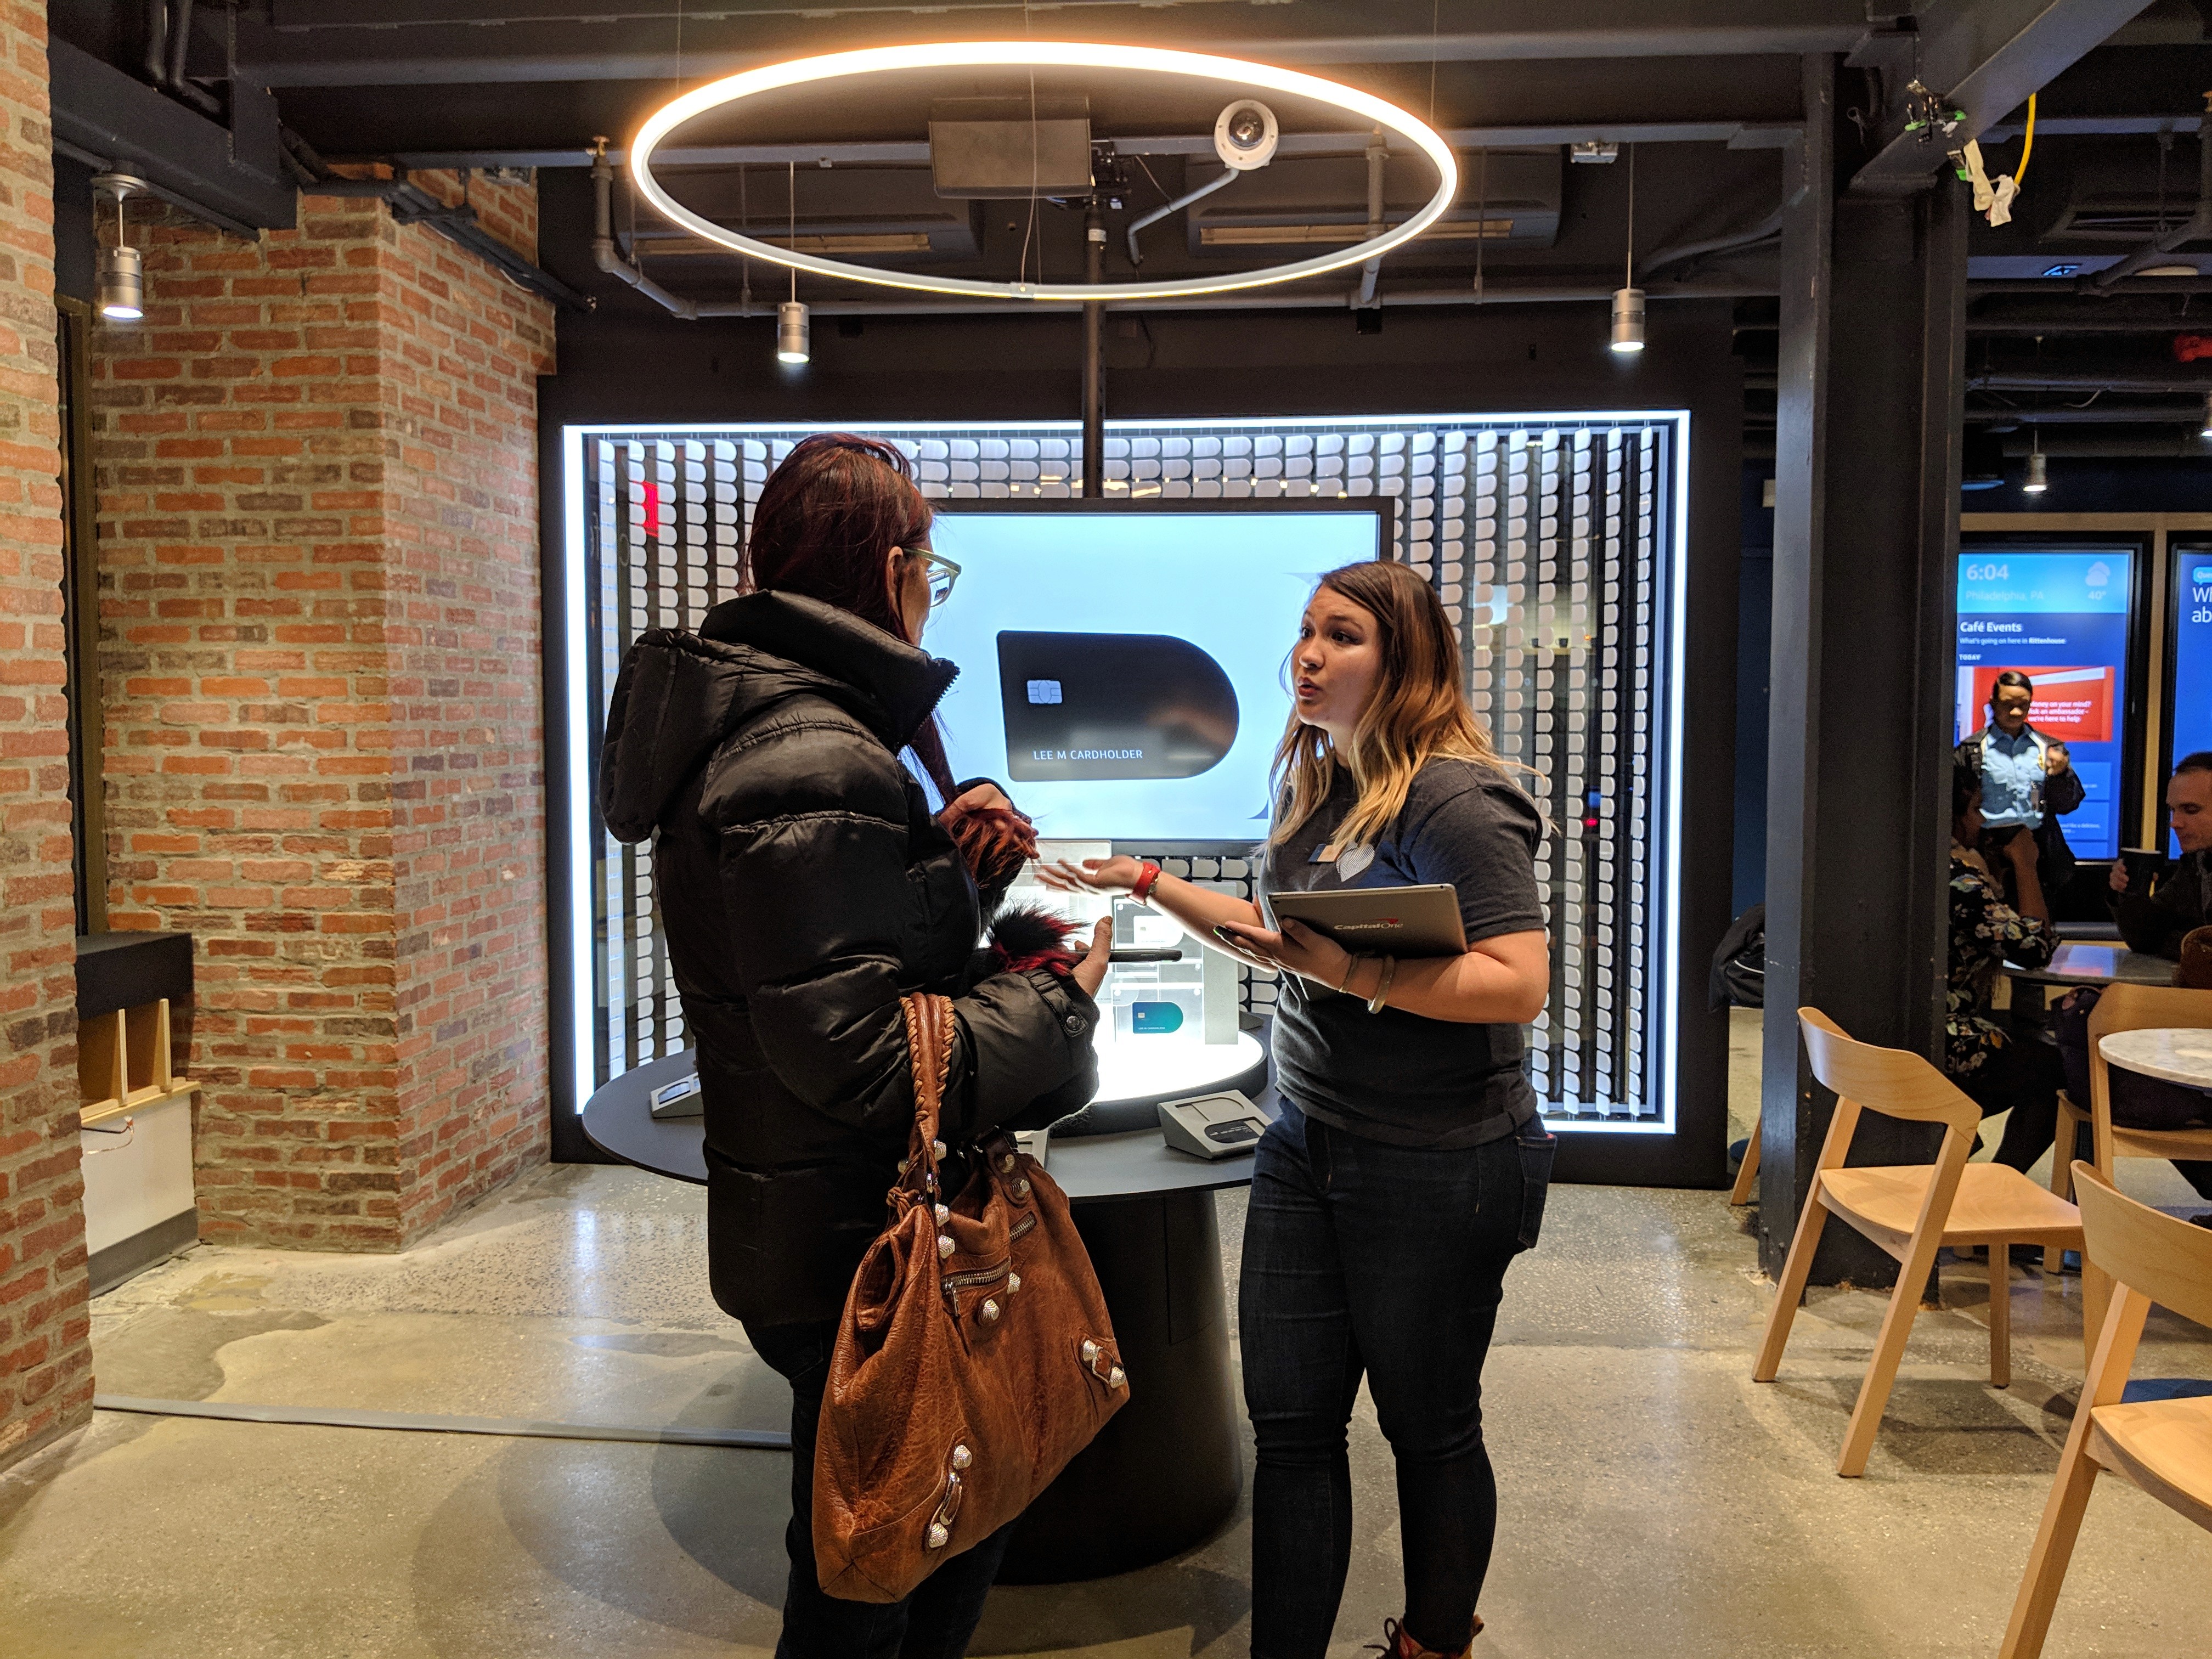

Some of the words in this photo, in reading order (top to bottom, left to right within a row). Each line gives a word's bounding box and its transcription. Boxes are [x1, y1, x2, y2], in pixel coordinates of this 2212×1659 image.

[1966, 564, 2009, 580] 6:04
[2030, 590, 2044, 600] PA
[1960, 622, 1985, 633] Café
[1987, 622, 2022, 633] Events
[1033, 750, 1053, 760] LEE
[1057, 750, 1066, 759] M
[1070, 749, 1143, 759] CARDHOLDER
